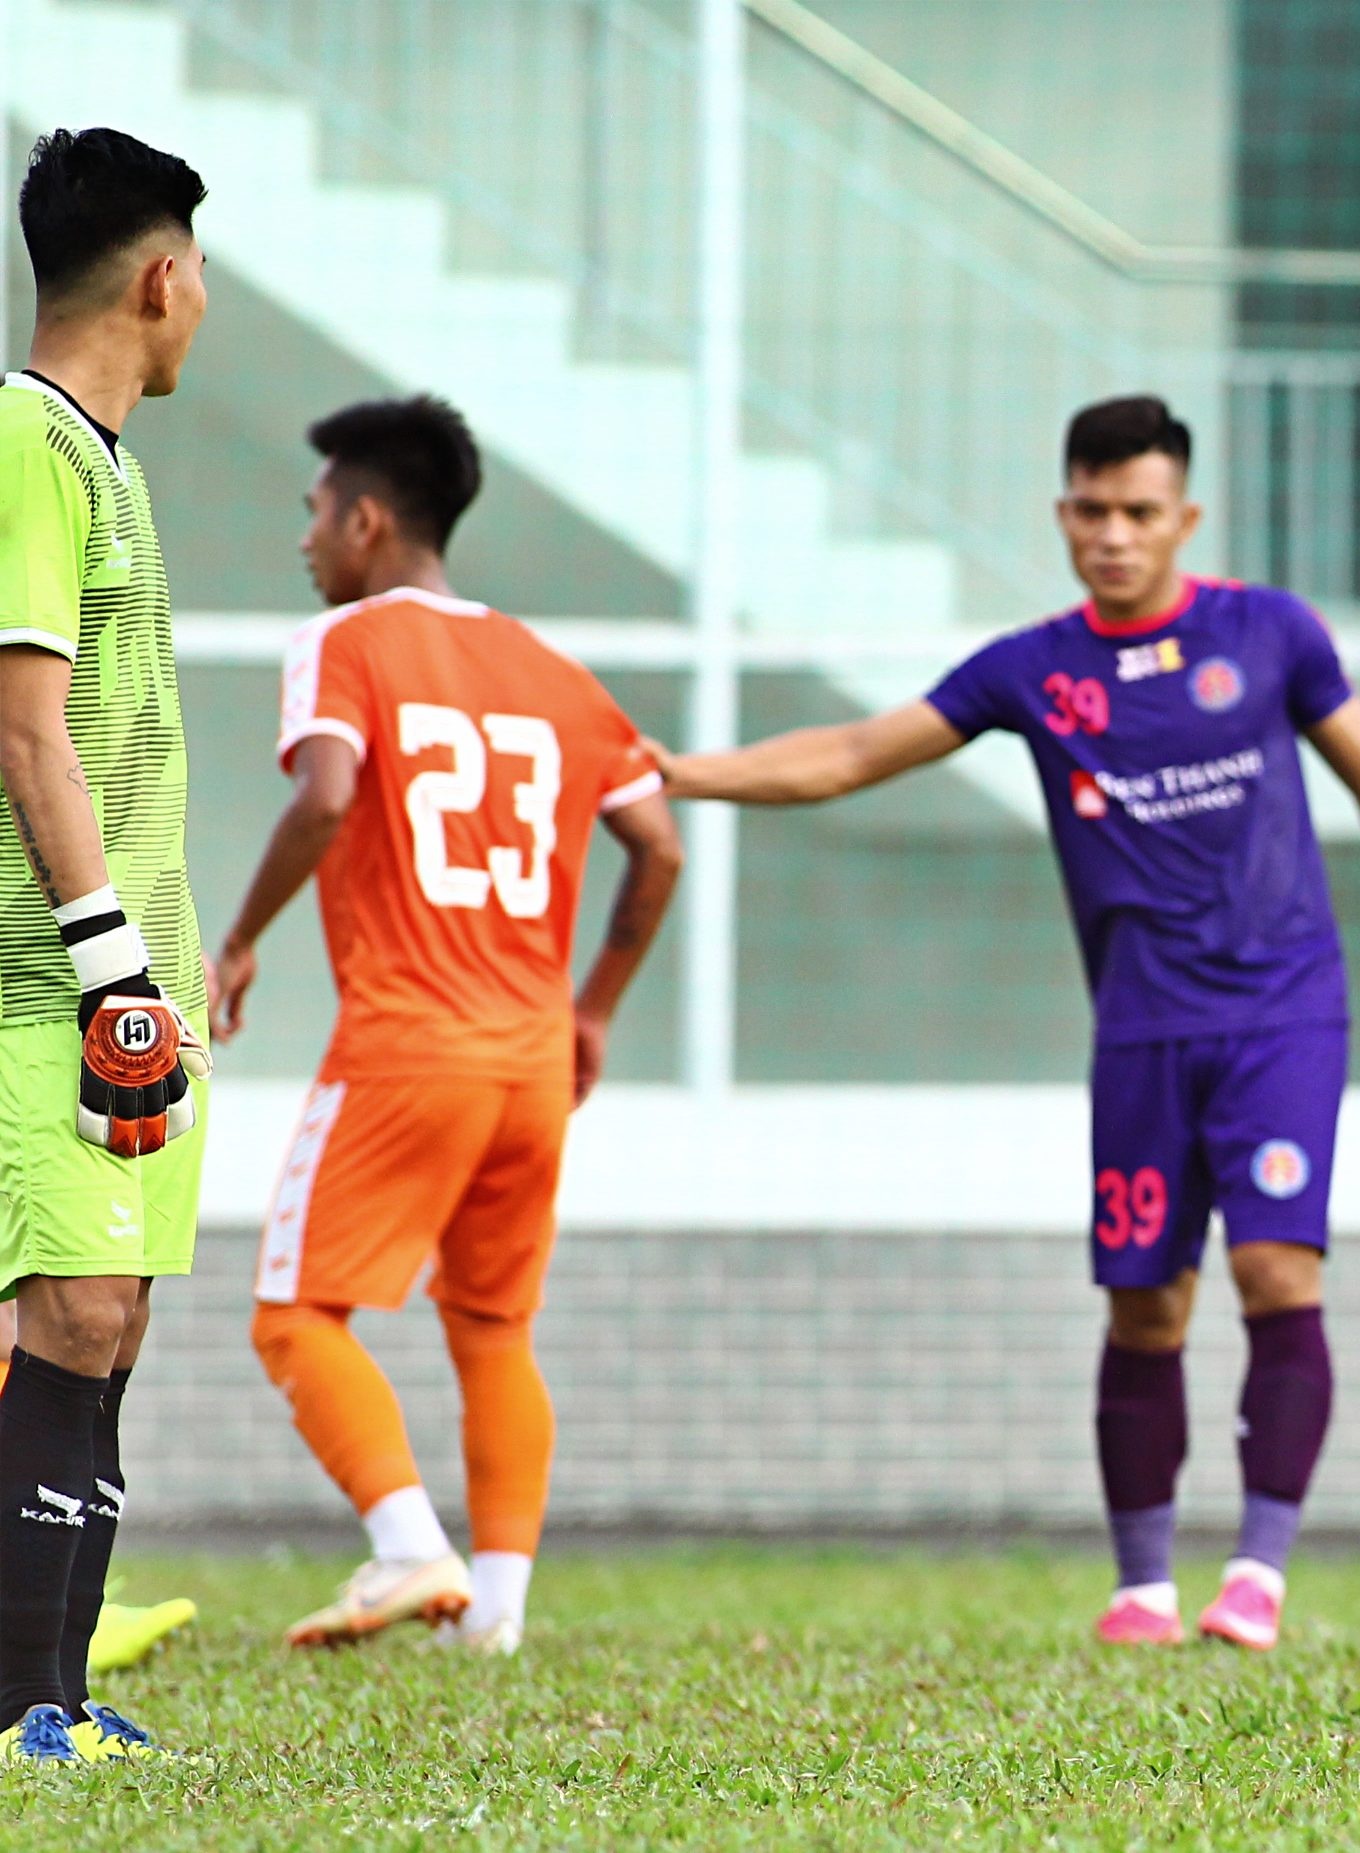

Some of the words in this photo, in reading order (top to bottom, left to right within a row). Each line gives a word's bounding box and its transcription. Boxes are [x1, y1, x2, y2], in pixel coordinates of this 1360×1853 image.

[1043, 672, 1111, 737] 39
[398, 702, 562, 919] 23
[1095, 1165, 1169, 1250] 39
